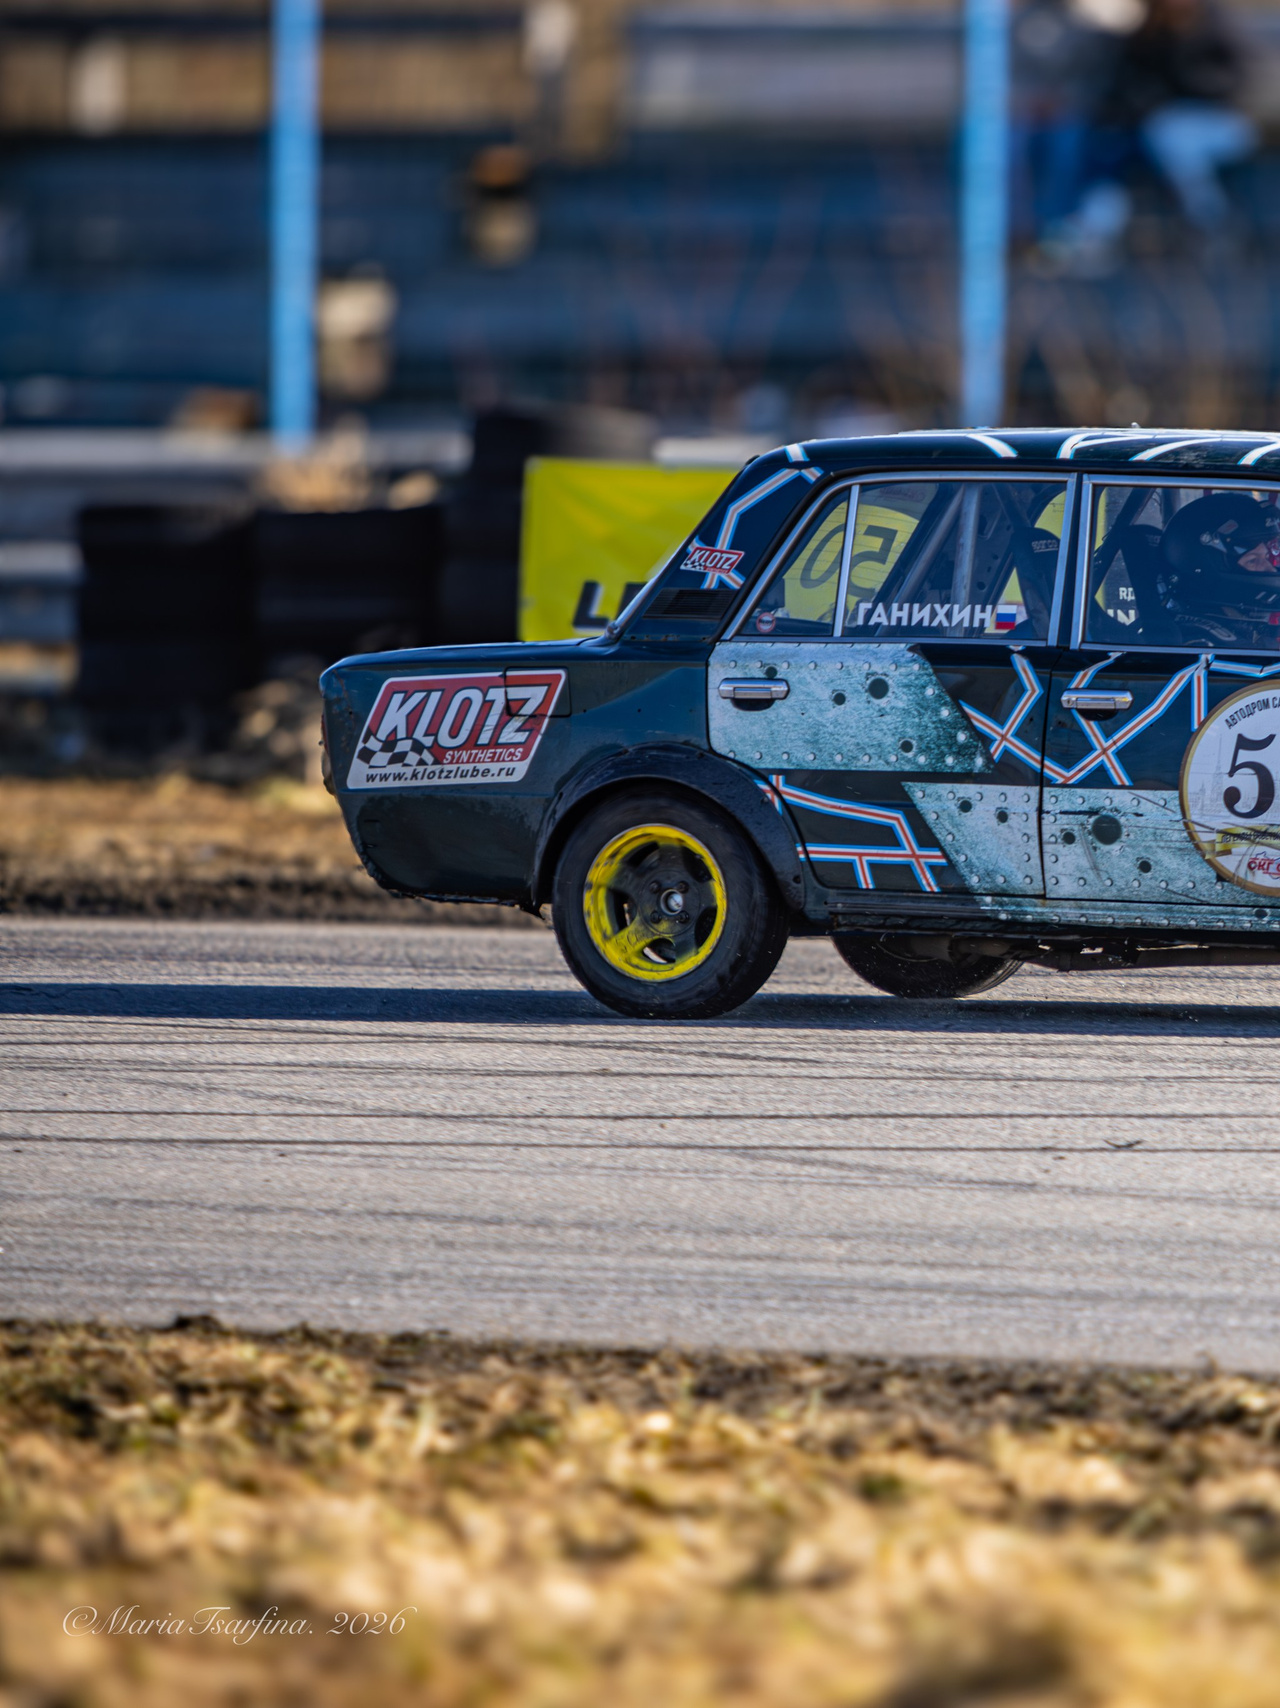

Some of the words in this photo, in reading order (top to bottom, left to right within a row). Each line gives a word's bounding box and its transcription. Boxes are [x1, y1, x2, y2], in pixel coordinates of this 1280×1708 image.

[689, 549, 739, 570] KLOTZ
[856, 602, 993, 628] ГАНИХИН
[374, 684, 552, 748] KLOTZ
[1224, 697, 1271, 729] АВТОДРОМ
[443, 747, 524, 764] SYNTHETICS
[365, 765, 516, 783] www.klotzlube.ru
